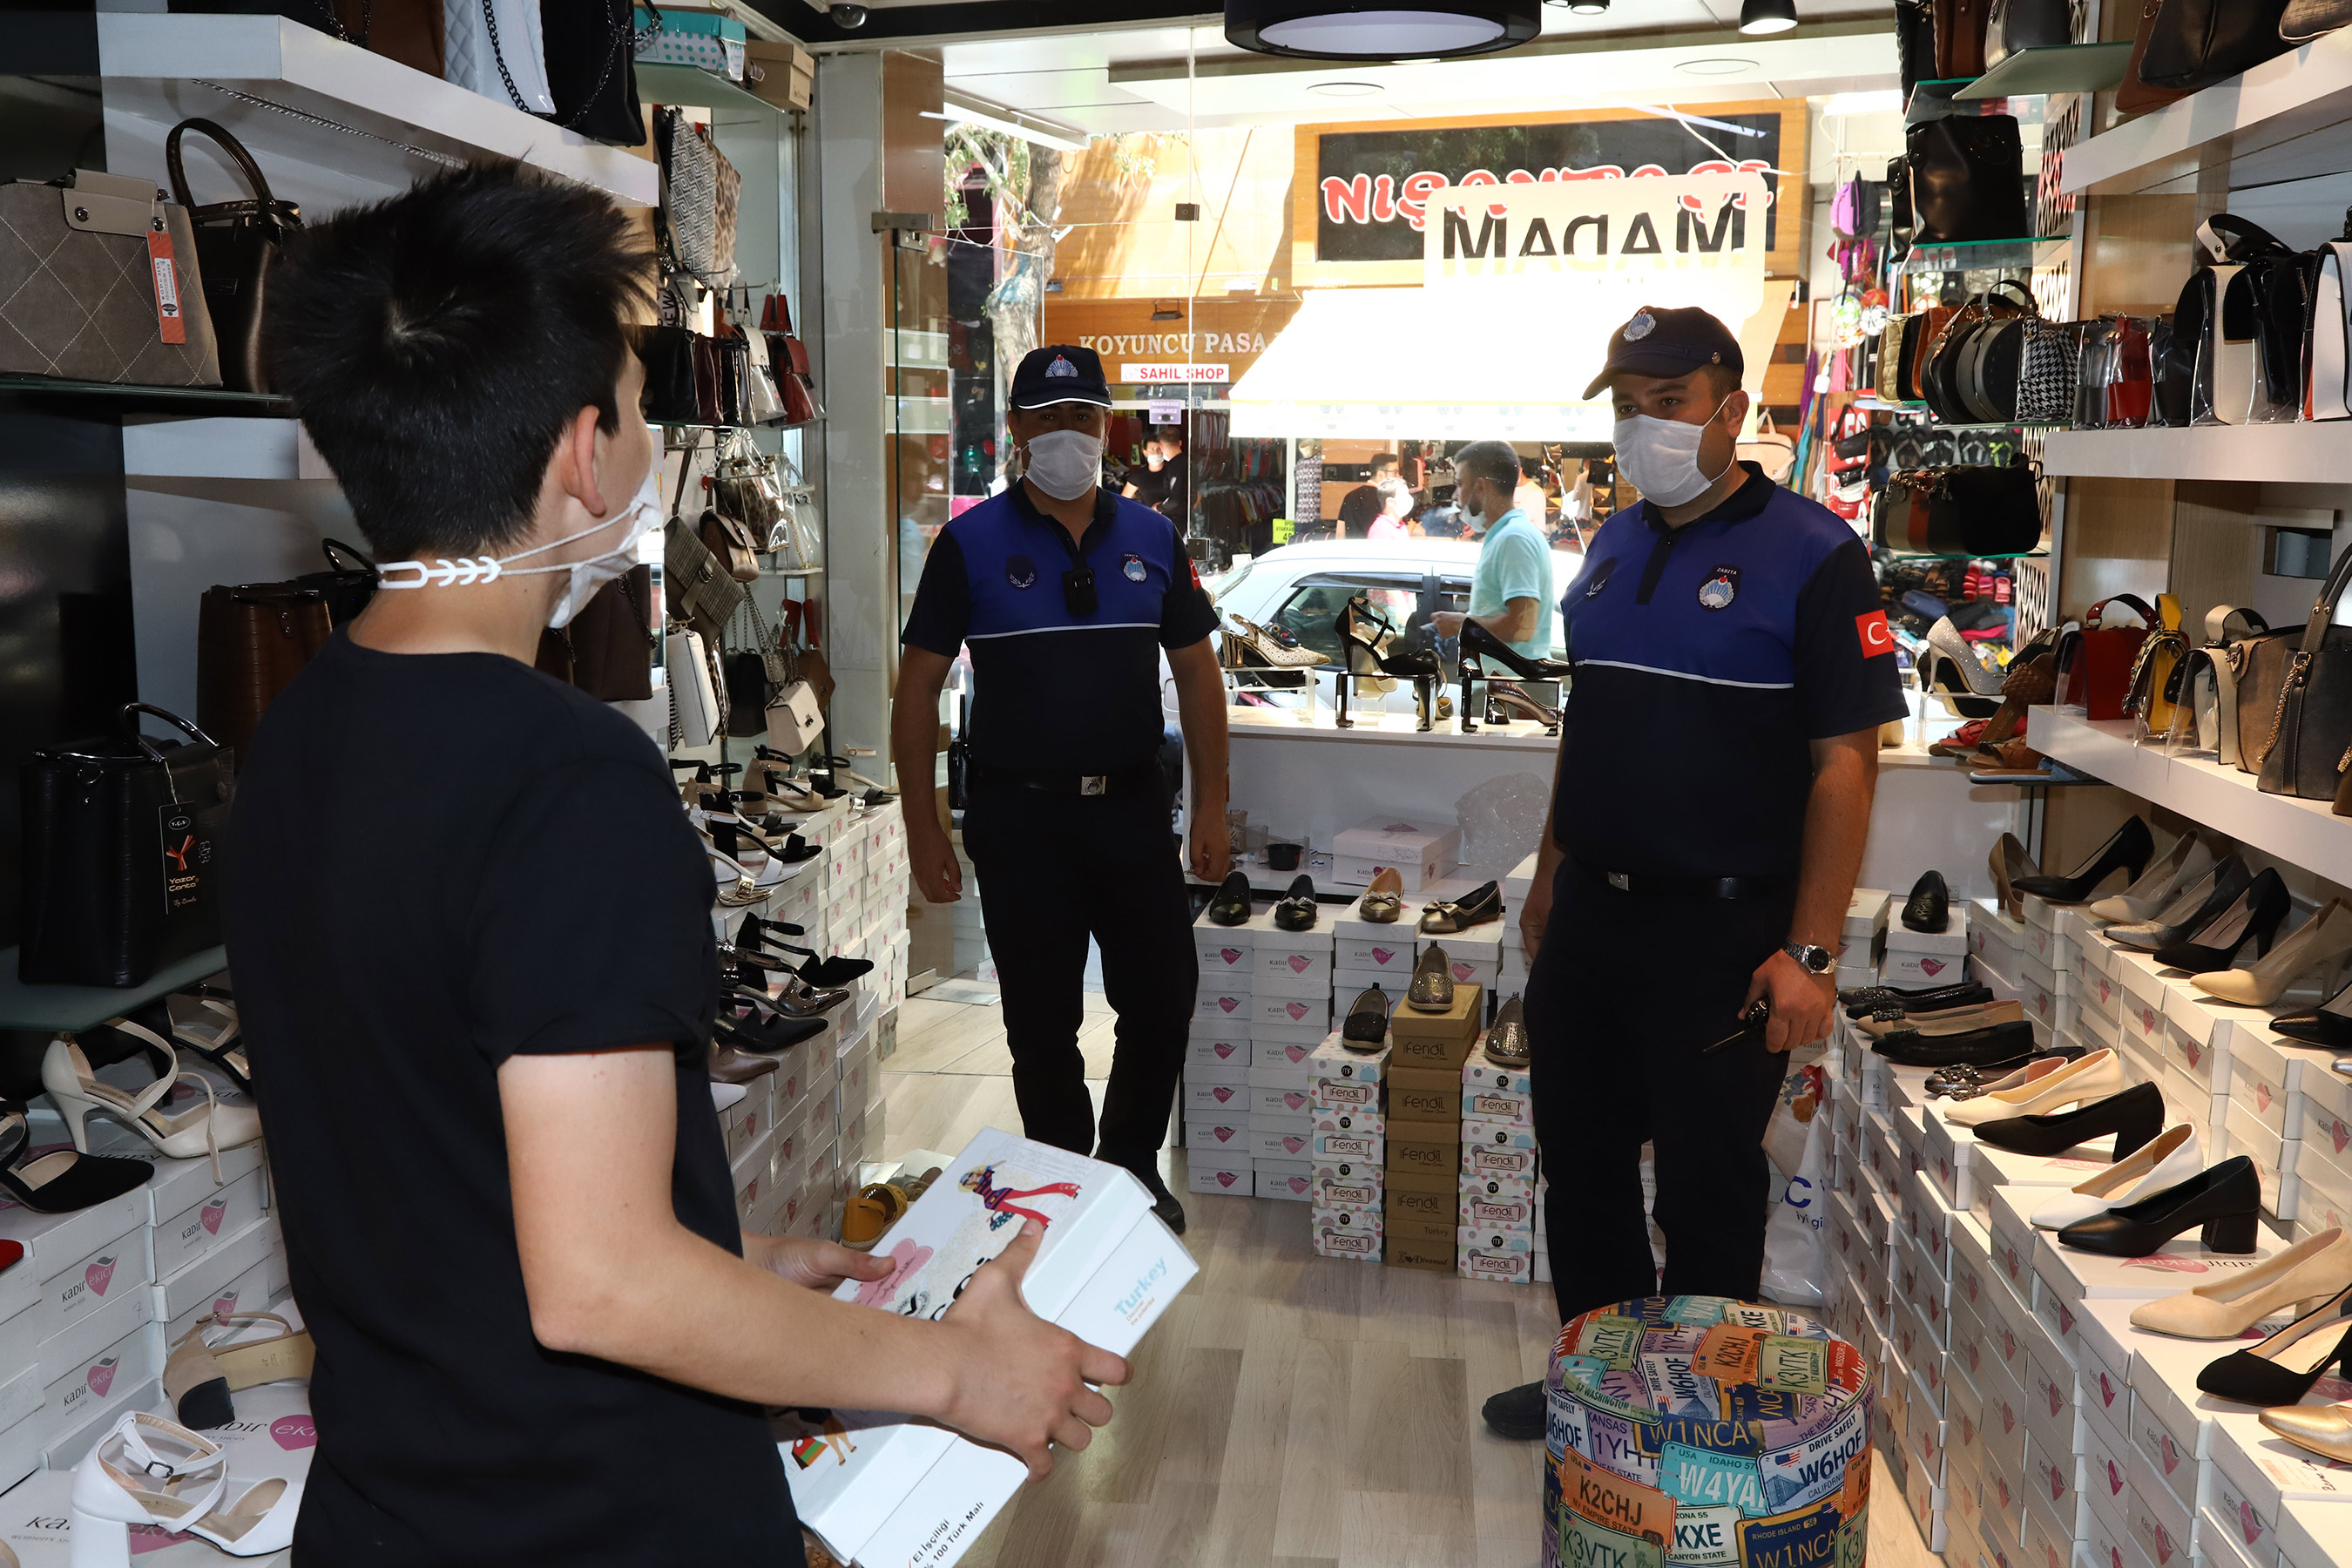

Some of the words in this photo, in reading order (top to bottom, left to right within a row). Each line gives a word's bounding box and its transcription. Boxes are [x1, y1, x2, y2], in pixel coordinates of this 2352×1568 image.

[1078, 334, 1195, 355] KOYUNCU
[1205, 333, 1288, 354] PASA
[1139, 364, 1181, 380] SAHİL
[1186, 367, 1225, 380] SHOP
[169, 875, 196, 885] Yazar
[1114, 1256, 1166, 1315] Turkey
[1713, 1336, 1751, 1369] K2CHJ
[1665, 1357, 1699, 1399] W6HOF
[1778, 1349, 1809, 1389] K3VTK
[1588, 1411, 1627, 1435] KANSAS
[1649, 1420, 1751, 1448] W1NCA
[1808, 1434, 1833, 1453] DRIVE
[1835, 1413, 1856, 1439] SAFELY
[1571, 1456, 1582, 1469] USA
[1679, 1449, 1698, 1461] USA
[1709, 1456, 1741, 1469] IDAHO
[1798, 1428, 1862, 1487] W6HOF
[1617, 1469, 1642, 1482] STATE
[1579, 1475, 1643, 1527] K2CHJ
[1582, 1506, 1611, 1527] EMPIRE
[1612, 1521, 1639, 1536] STATE
[1752, 1531, 1777, 1540] RHODE
[1778, 1524, 1801, 1536] ISLAND
[933, 1544, 949, 1561] 100
[947, 1522, 968, 1544] Türk
[1564, 1525, 1627, 1568] K3VTK
[913, 1551, 924, 1563] El
[1668, 1552, 1700, 1561] CANYON
[1702, 1551, 1727, 1560] STATE
